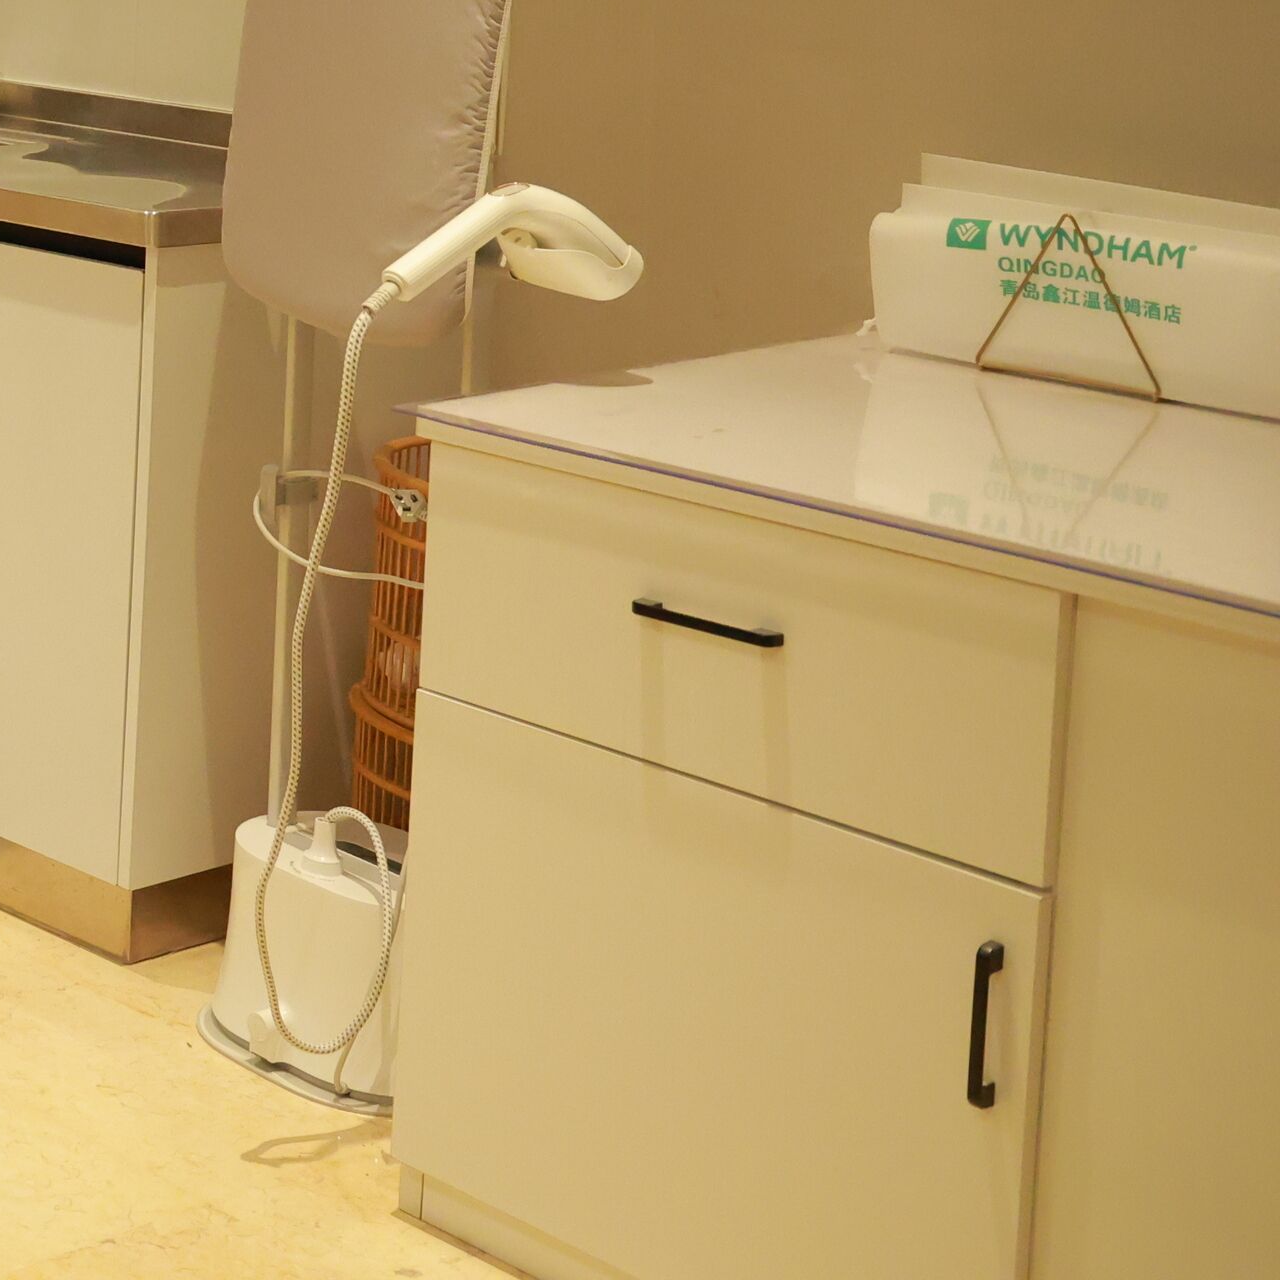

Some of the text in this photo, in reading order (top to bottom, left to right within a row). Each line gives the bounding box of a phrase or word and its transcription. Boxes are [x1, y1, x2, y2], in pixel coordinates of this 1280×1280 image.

[999, 223, 1186, 269] WYNDHAM
[998, 257, 1105, 283] QINGDAO
[999, 279, 1182, 324] 青岛鑫江温德姆酒店
